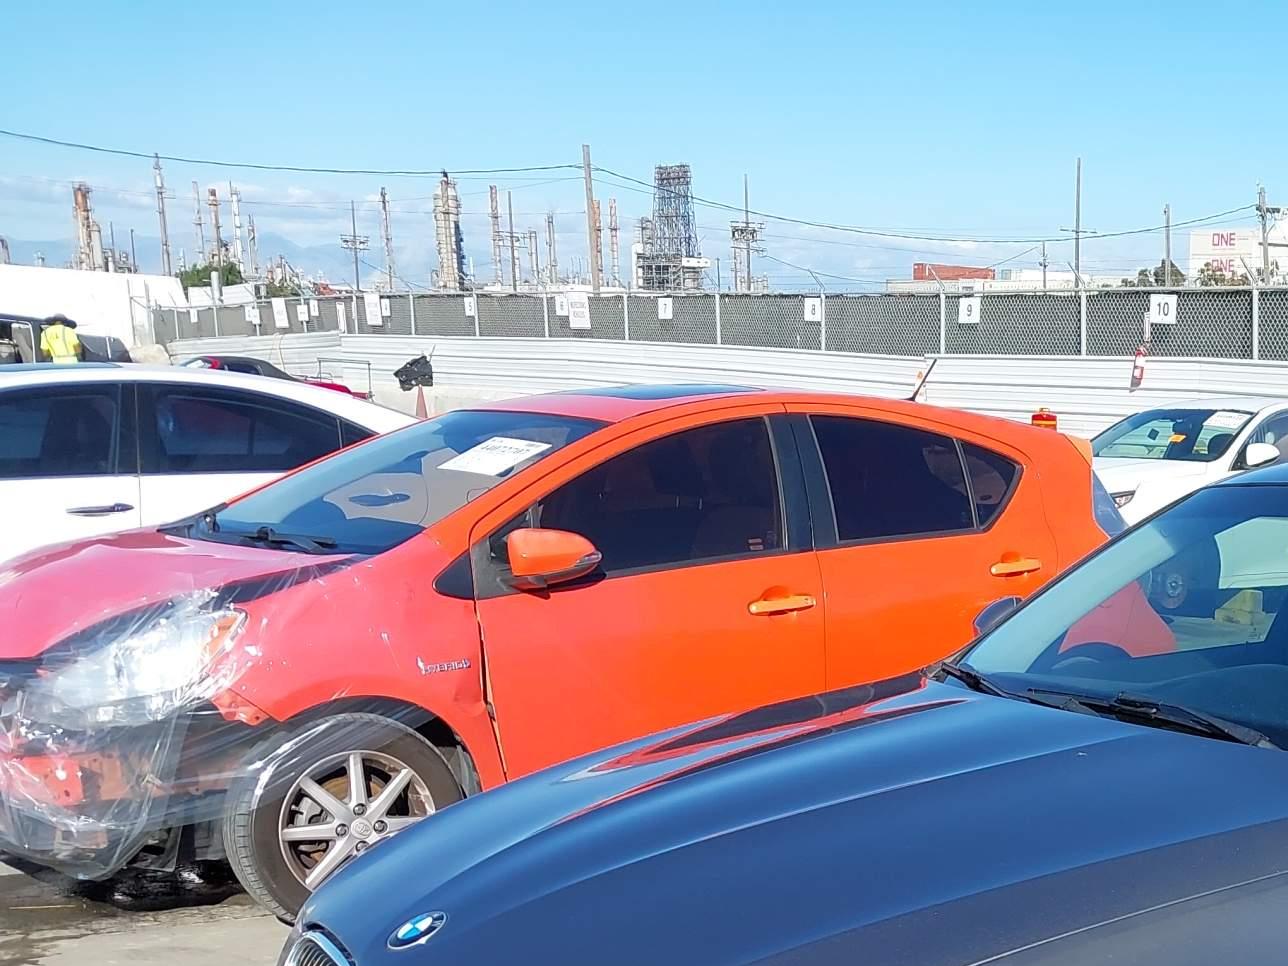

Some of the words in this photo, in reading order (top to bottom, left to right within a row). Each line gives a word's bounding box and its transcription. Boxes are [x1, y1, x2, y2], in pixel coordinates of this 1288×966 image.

[1212, 232, 1236, 247] ONE
[966, 304, 973, 317] 9
[1157, 302, 1169, 317] 10
